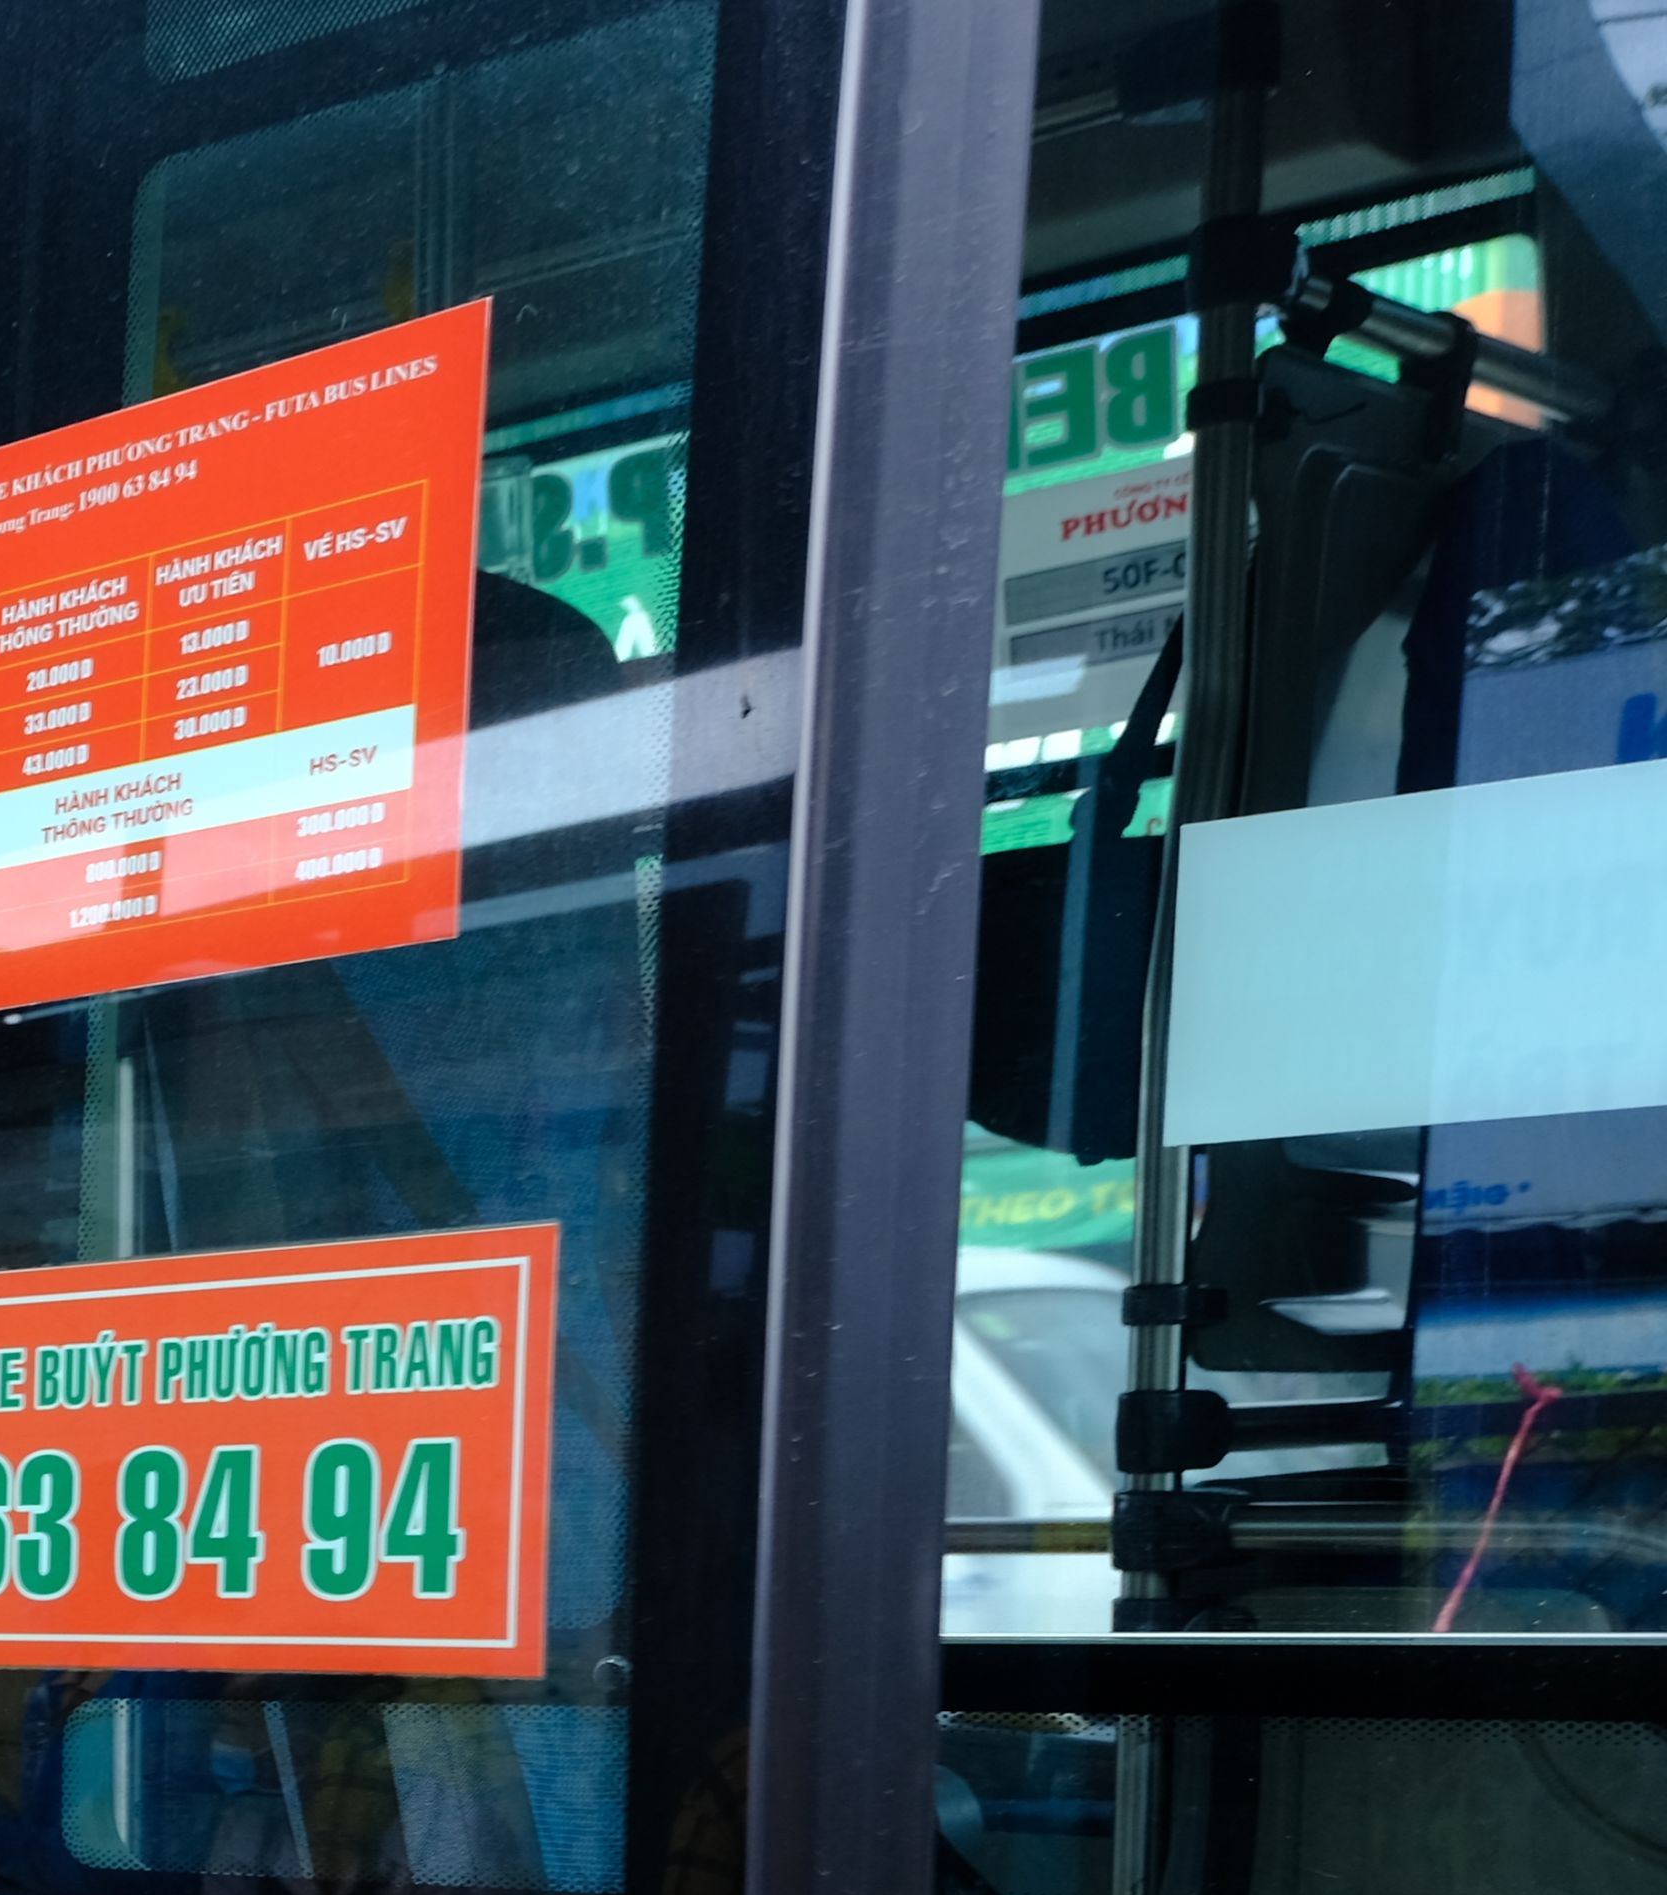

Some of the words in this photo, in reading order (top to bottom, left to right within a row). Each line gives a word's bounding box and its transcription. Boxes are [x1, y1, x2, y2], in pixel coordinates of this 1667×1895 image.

[12, 465, 82, 496] KHÁCH
[85, 433, 172, 475] PHƯƠNG
[176, 410, 250, 448] TRANG
[264, 391, 320, 423] FUTA
[323, 375, 367, 405] BUS
[369, 354, 438, 392] LINES
[77, 482, 119, 513] 1900
[122, 475, 146, 499] 63
[147, 468, 172, 492] 84
[173, 459, 199, 484] 94
[154, 554, 211, 586] HÀNH
[213, 533, 284, 570] KHÁCH
[304, 531, 334, 562] VÉ
[334, 516, 408, 555] HS-SV
[1, 596, 56, 627] HÀNH
[58, 575, 129, 612] KHÁCH
[210, 571, 257, 600] TIÊN
[54, 788, 110, 816] HÀNH
[113, 771, 183, 803] KHÁCH
[308, 744, 379, 777] HS-SV
[41, 814, 107, 845] THÔNG
[112, 796, 195, 832] THƯỜNG
[34, 1328, 146, 1410] BUÝT
[157, 1321, 331, 1404] PHƯƠNG
[344, 1315, 501, 1395] TRANG
[117, 1443, 264, 1603] 84
[302, 1436, 466, 1603] 94
